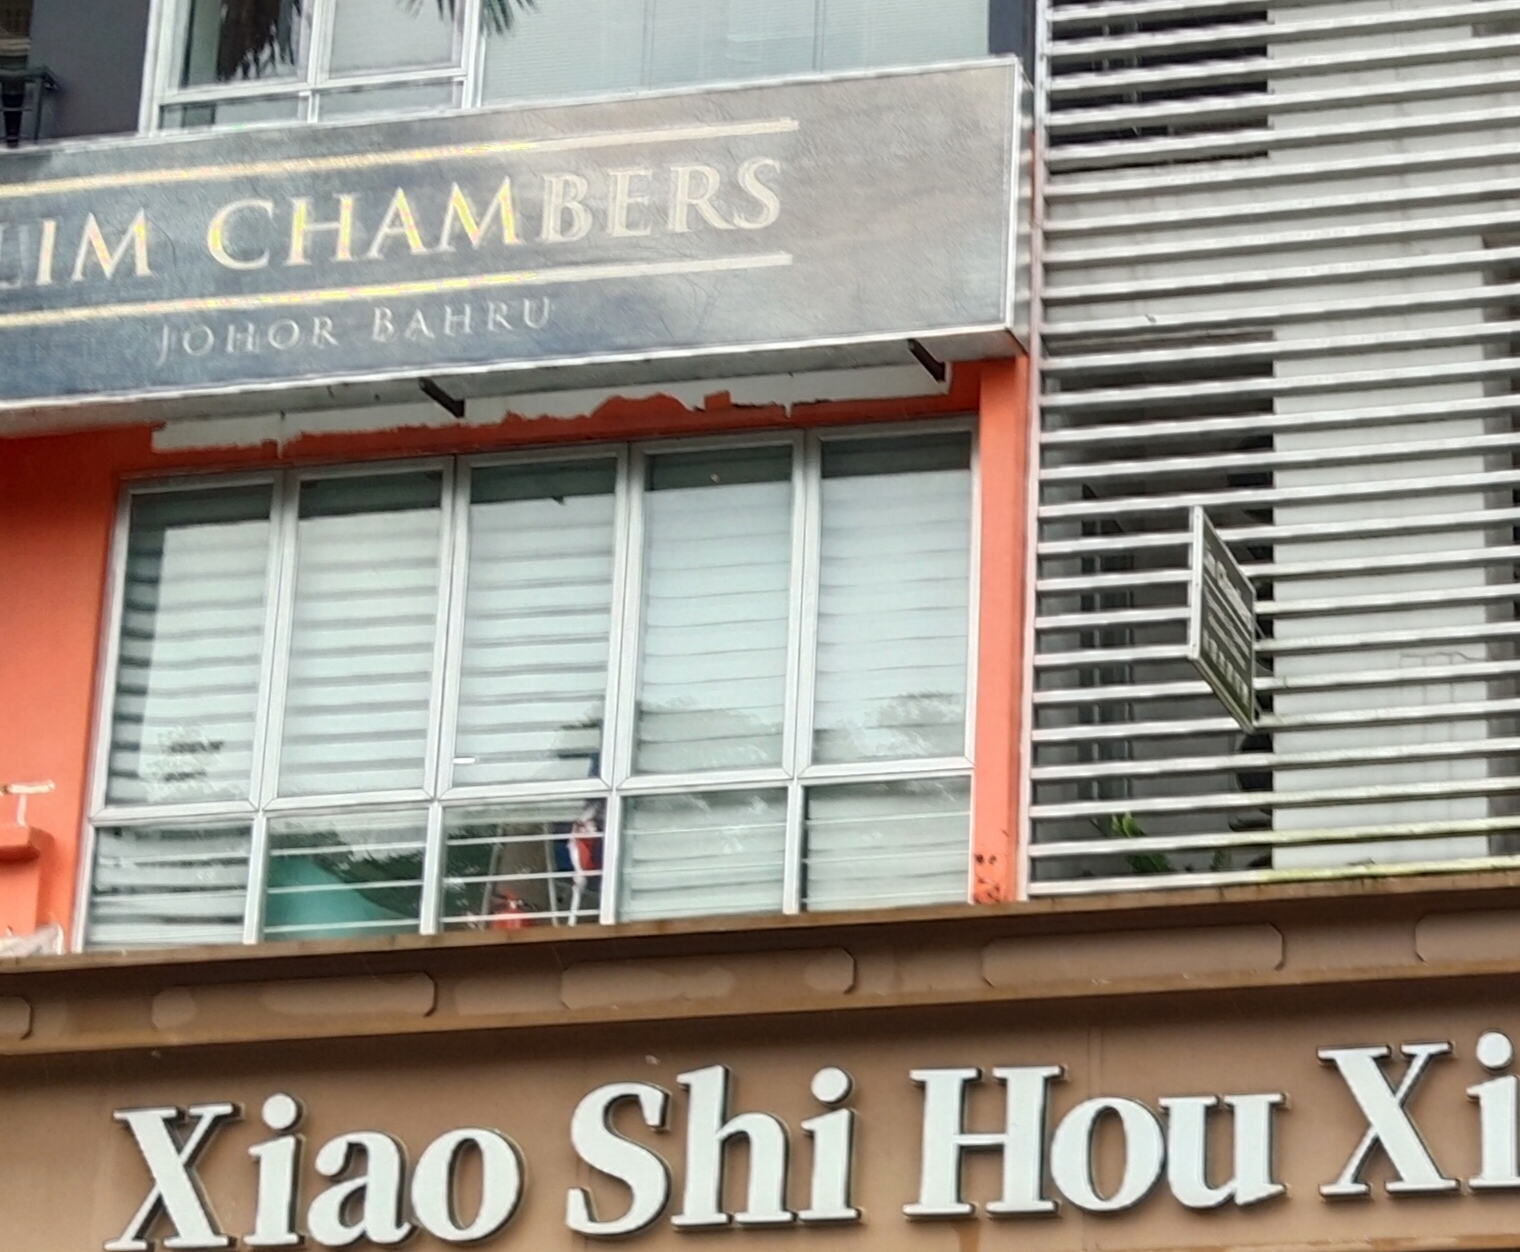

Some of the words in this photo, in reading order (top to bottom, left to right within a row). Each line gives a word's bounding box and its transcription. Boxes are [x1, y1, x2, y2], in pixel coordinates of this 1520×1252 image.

[206, 156, 783, 271] CHAMBERS
[154, 315, 341, 367] JOHOR
[371, 296, 556, 344] BAHRU
[566, 1065, 862, 1238] Shi
[902, 1062, 1290, 1221] Hou
